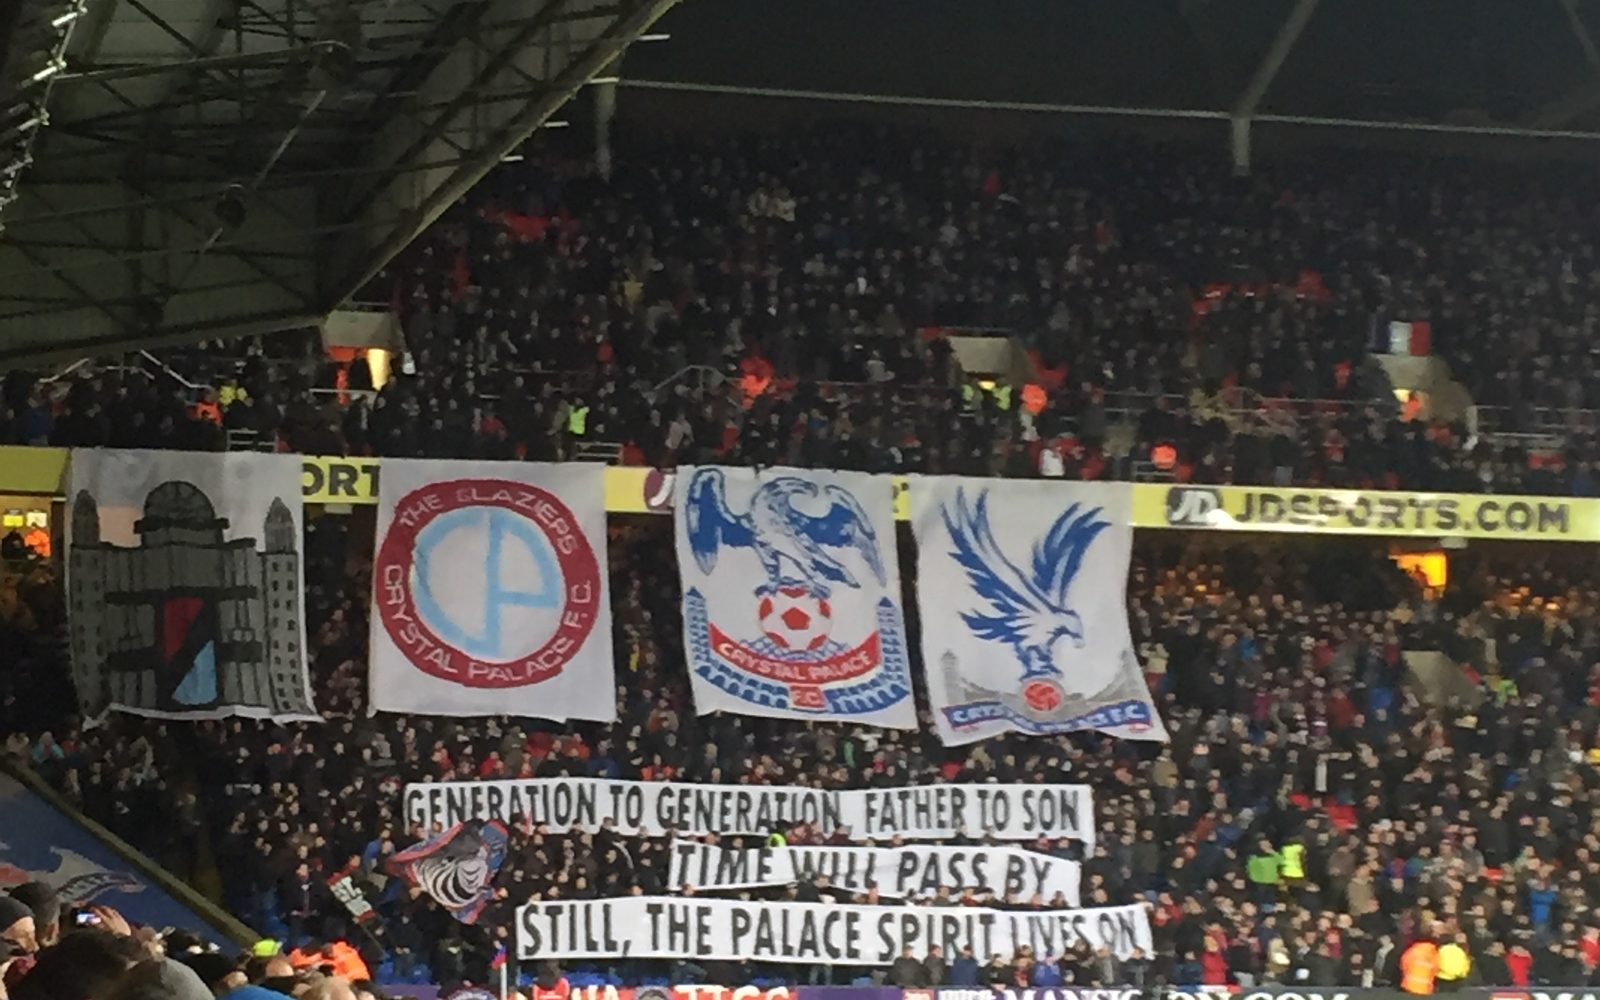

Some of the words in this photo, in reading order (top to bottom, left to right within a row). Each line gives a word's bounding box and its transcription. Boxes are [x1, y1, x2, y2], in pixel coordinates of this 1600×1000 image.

[399, 494, 445, 527] THE
[384, 564, 458, 674] CRYSTAL
[468, 637, 575, 681] PALACE
[407, 782, 597, 827] GENERATION
[609, 785, 643, 827] TO
[865, 788, 967, 831] FATHER
[976, 788, 1011, 829] TO
[1022, 789, 1080, 831] SON
[677, 844, 774, 886] TIME
[789, 849, 879, 889] WILL
[897, 851, 989, 893] PASS
[1004, 854, 1054, 893] BY
[523, 903, 632, 958] STILL,
[646, 903, 713, 952] THE
[731, 907, 862, 960] PALACE
[877, 912, 998, 962] SPIRIT
[1097, 911, 1141, 953] ON
